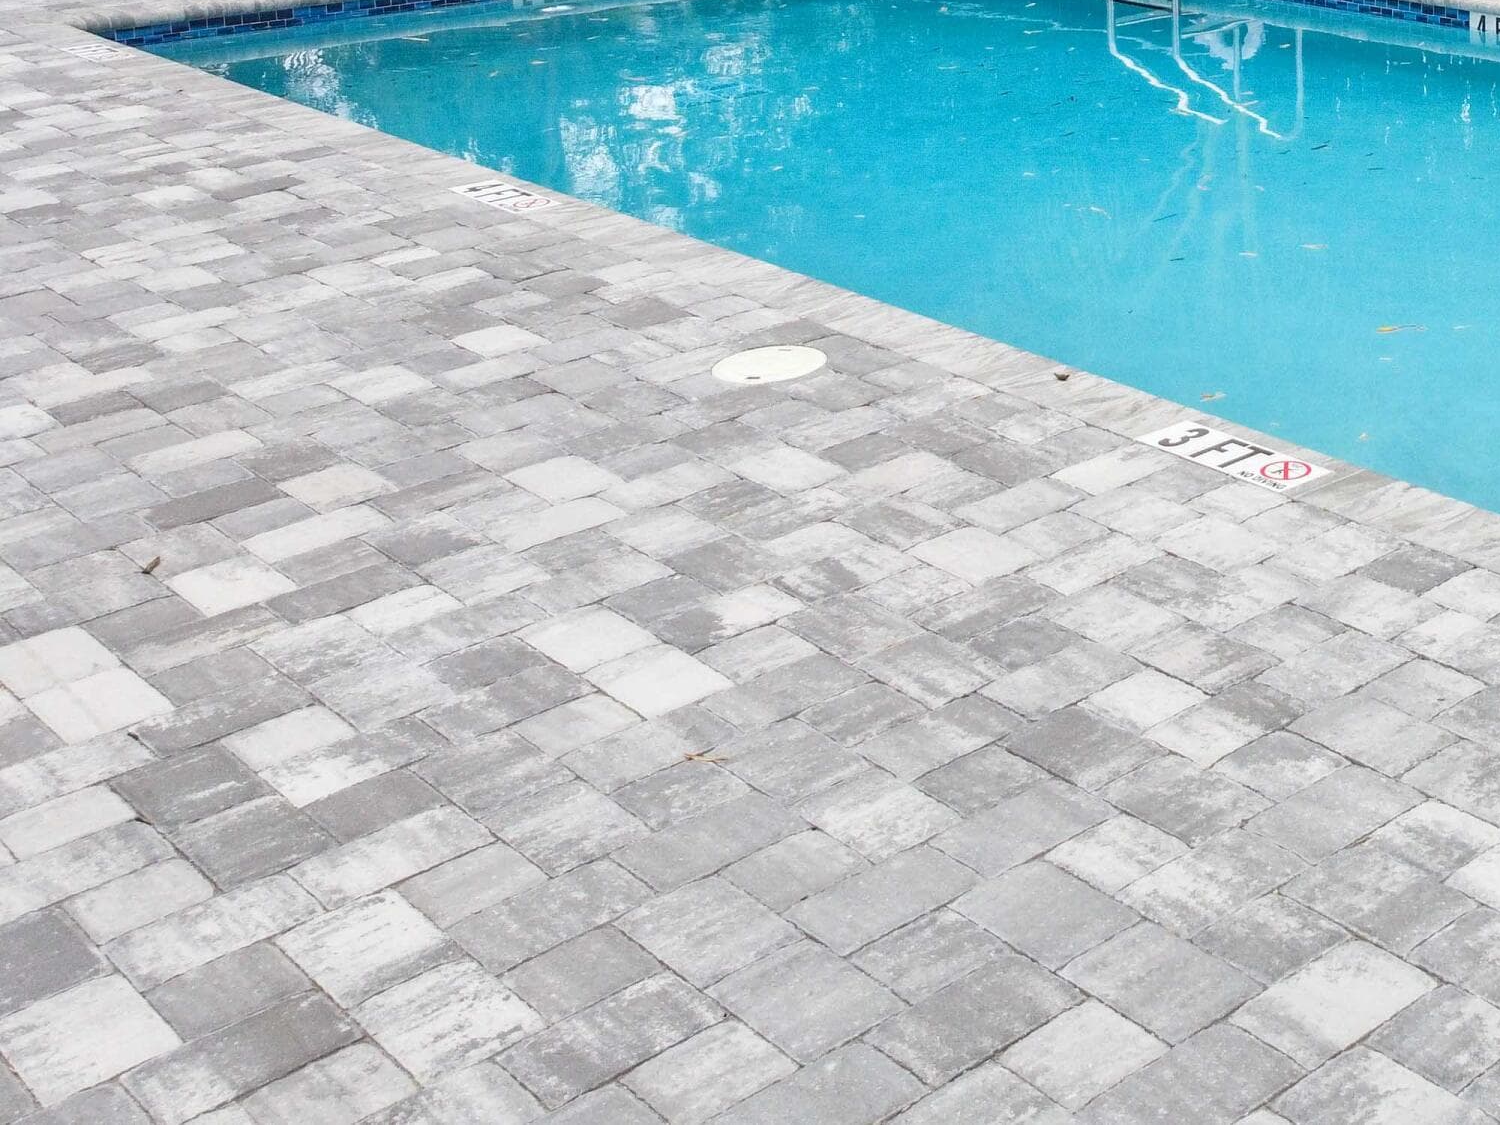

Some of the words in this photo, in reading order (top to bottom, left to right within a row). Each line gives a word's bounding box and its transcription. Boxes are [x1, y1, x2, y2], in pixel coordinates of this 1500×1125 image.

[474, 188, 534, 203] FT
[1158, 428, 1210, 448] 3
[1189, 438, 1275, 469] FT
